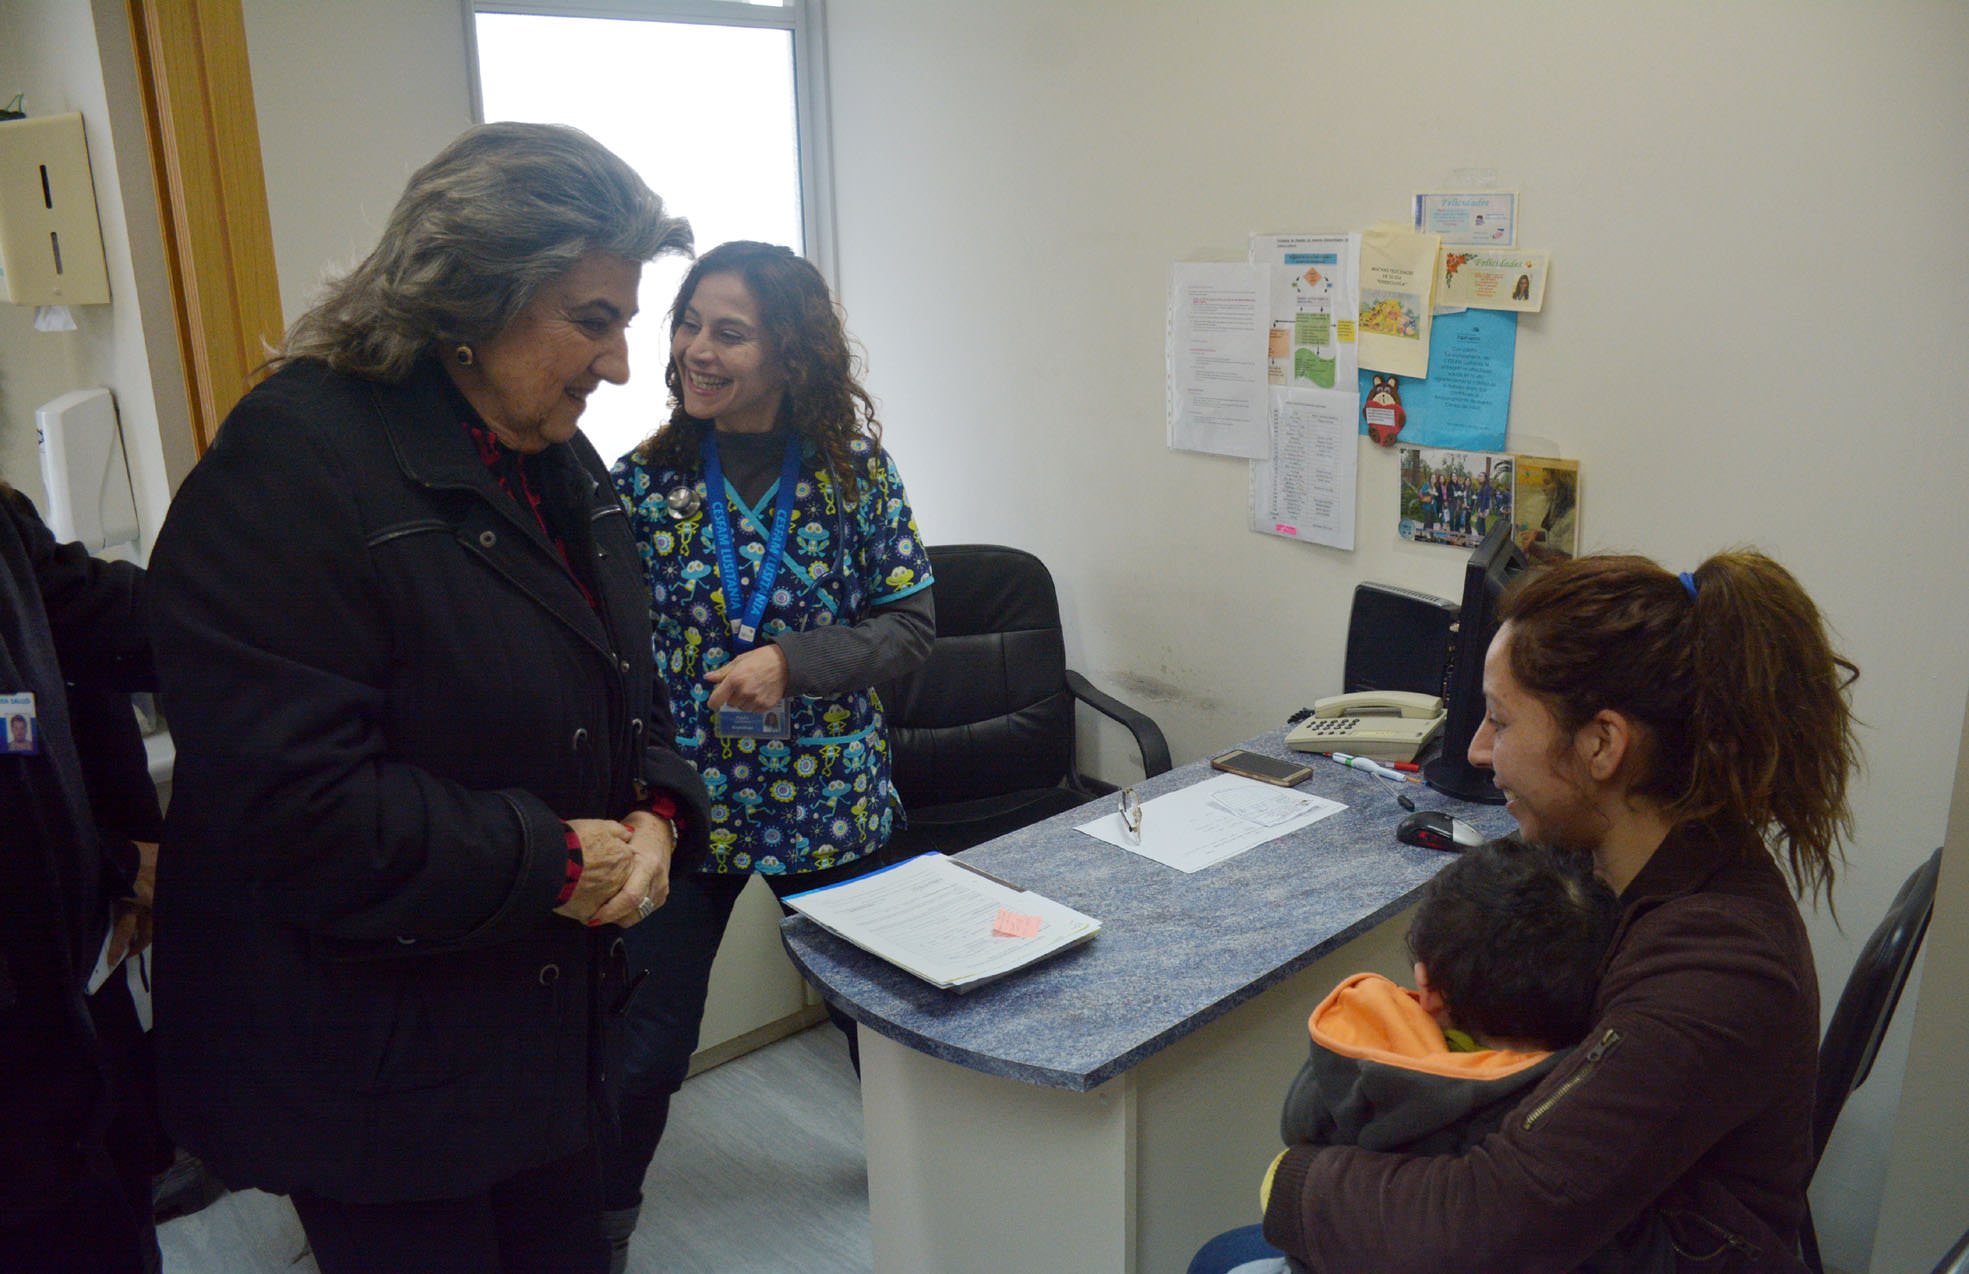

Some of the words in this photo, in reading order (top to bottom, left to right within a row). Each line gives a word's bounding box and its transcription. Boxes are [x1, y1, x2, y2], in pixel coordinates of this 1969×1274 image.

[1474, 258, 1523, 268] Felicidades
[712, 501, 730, 546] CESFAM
[768, 508, 788, 555] CESFAM
[720, 548, 741, 610] LUSITANIA
